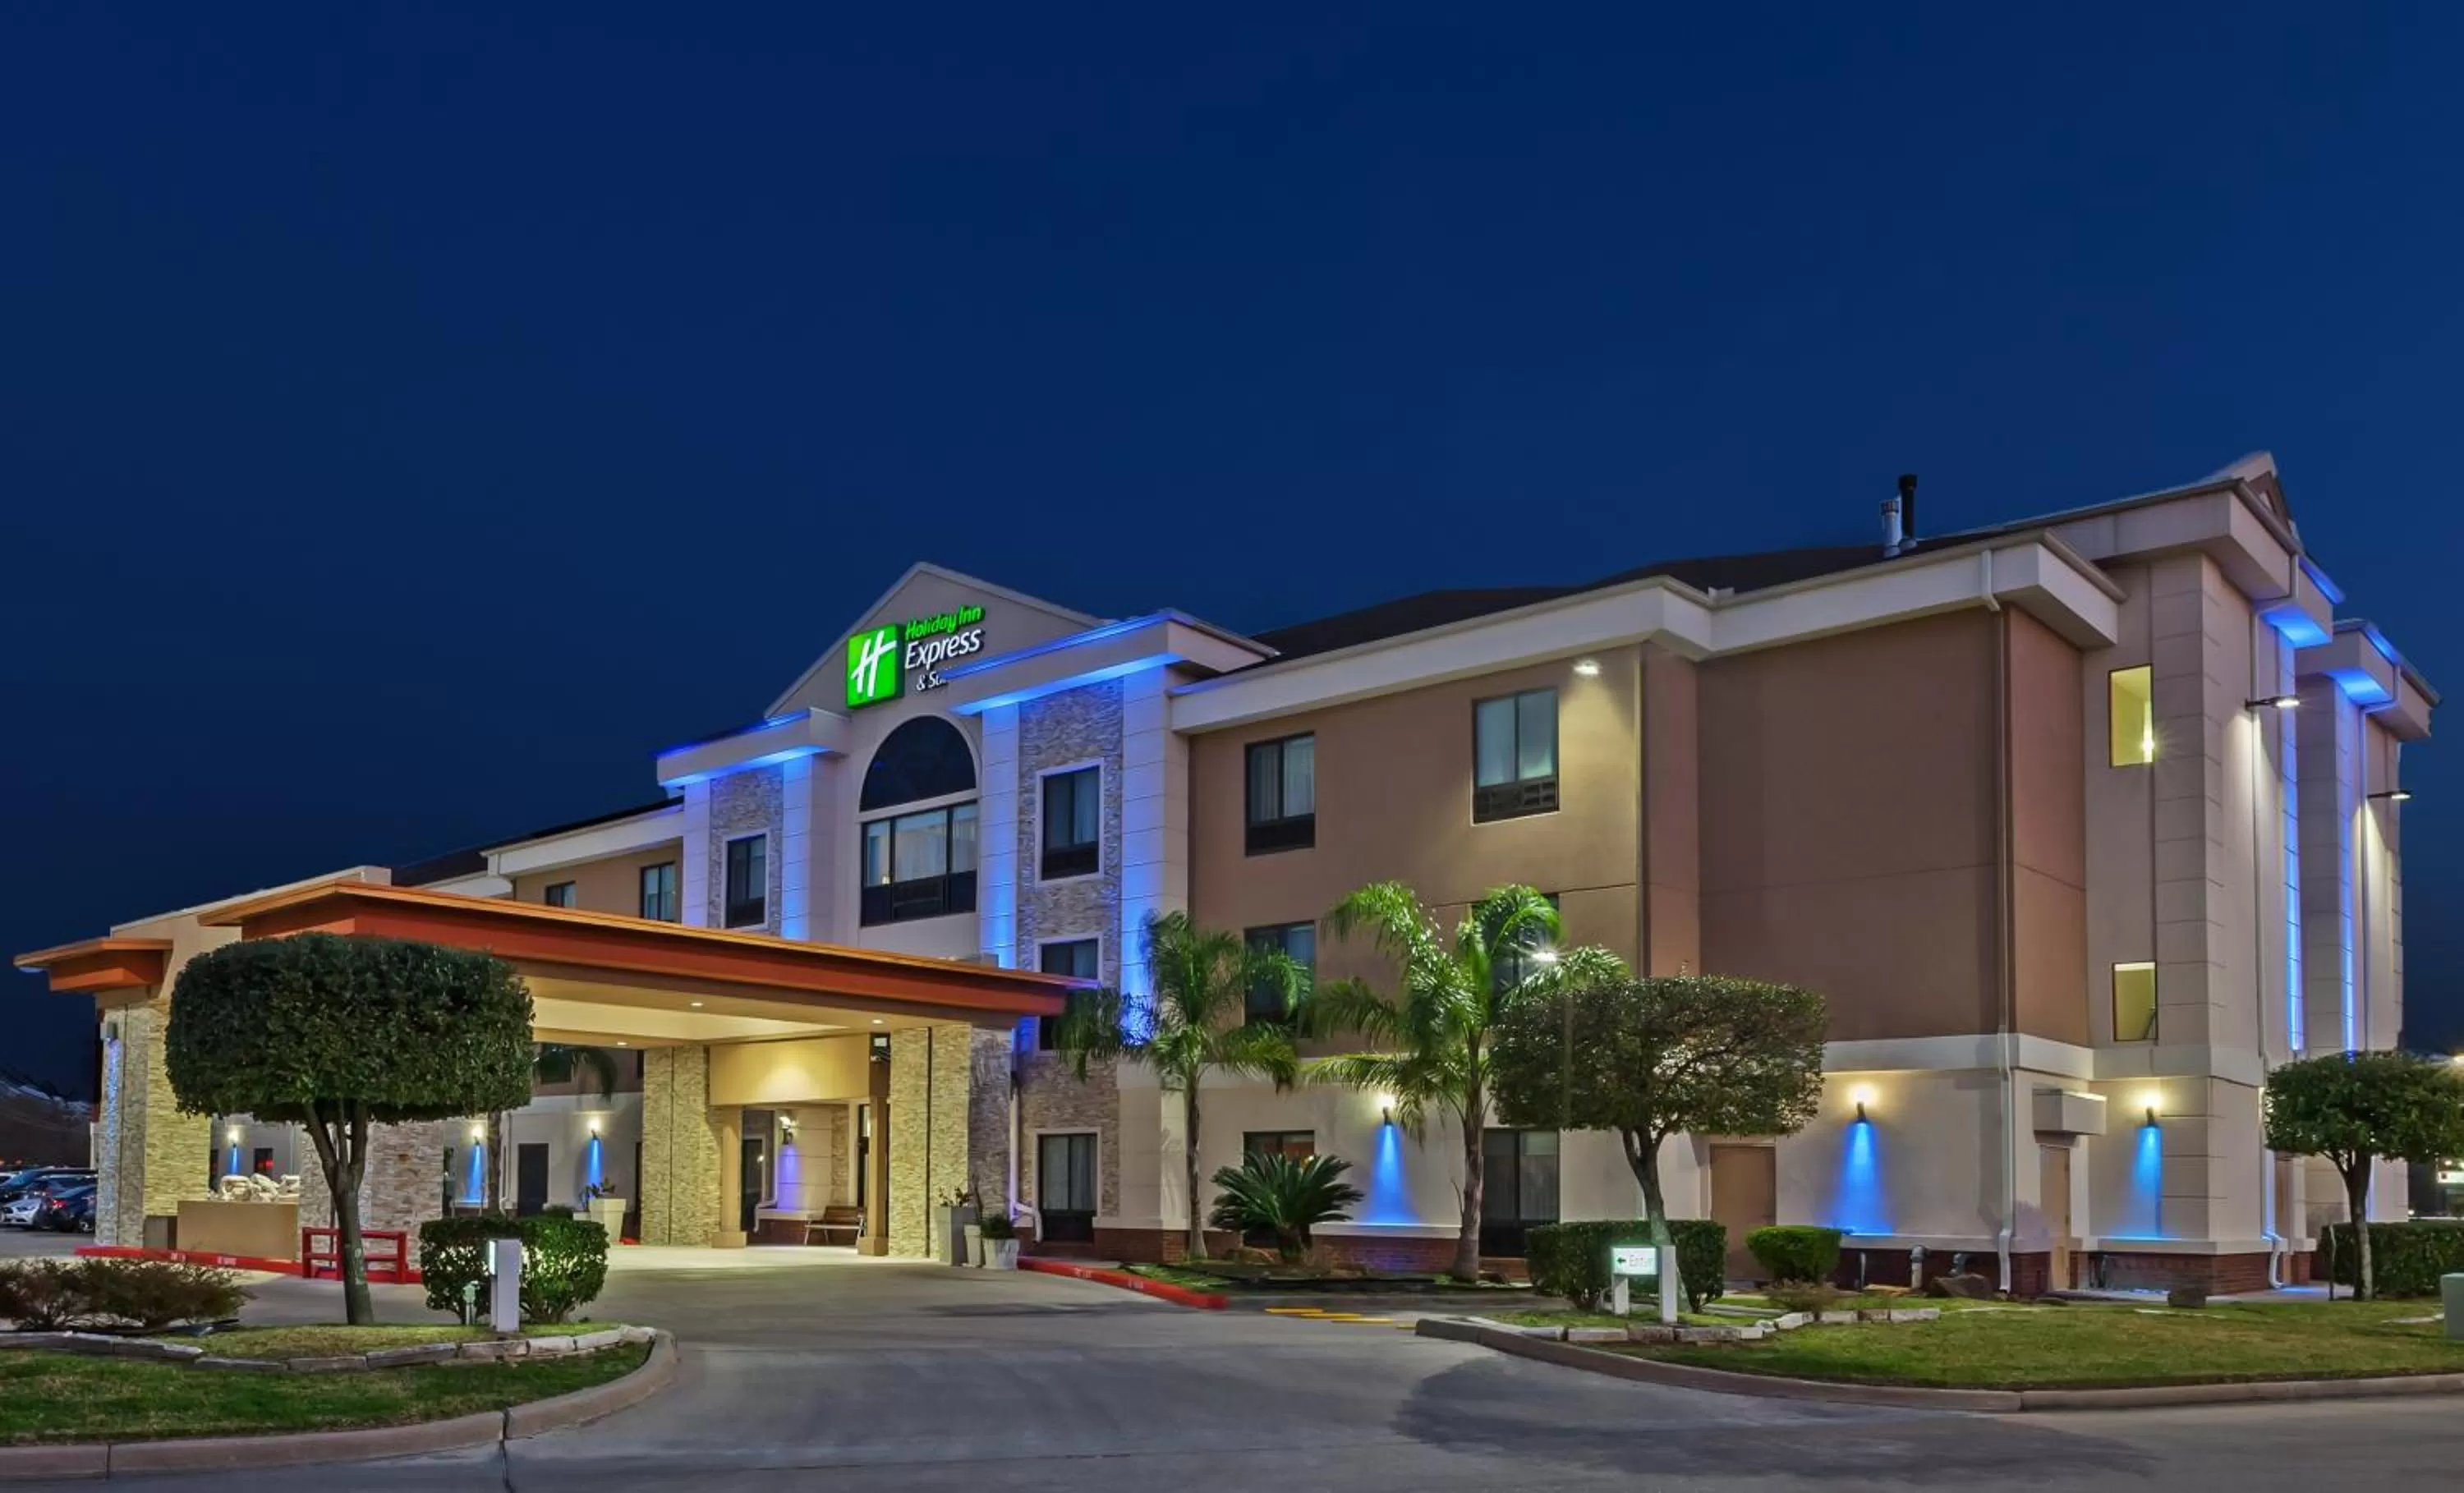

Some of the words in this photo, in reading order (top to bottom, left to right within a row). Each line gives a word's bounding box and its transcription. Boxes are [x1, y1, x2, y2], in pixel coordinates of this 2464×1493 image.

[904, 613, 957, 641] Holiday
[958, 605, 982, 626] Inn
[904, 628, 981, 671] Express
[916, 673, 926, 691] &
